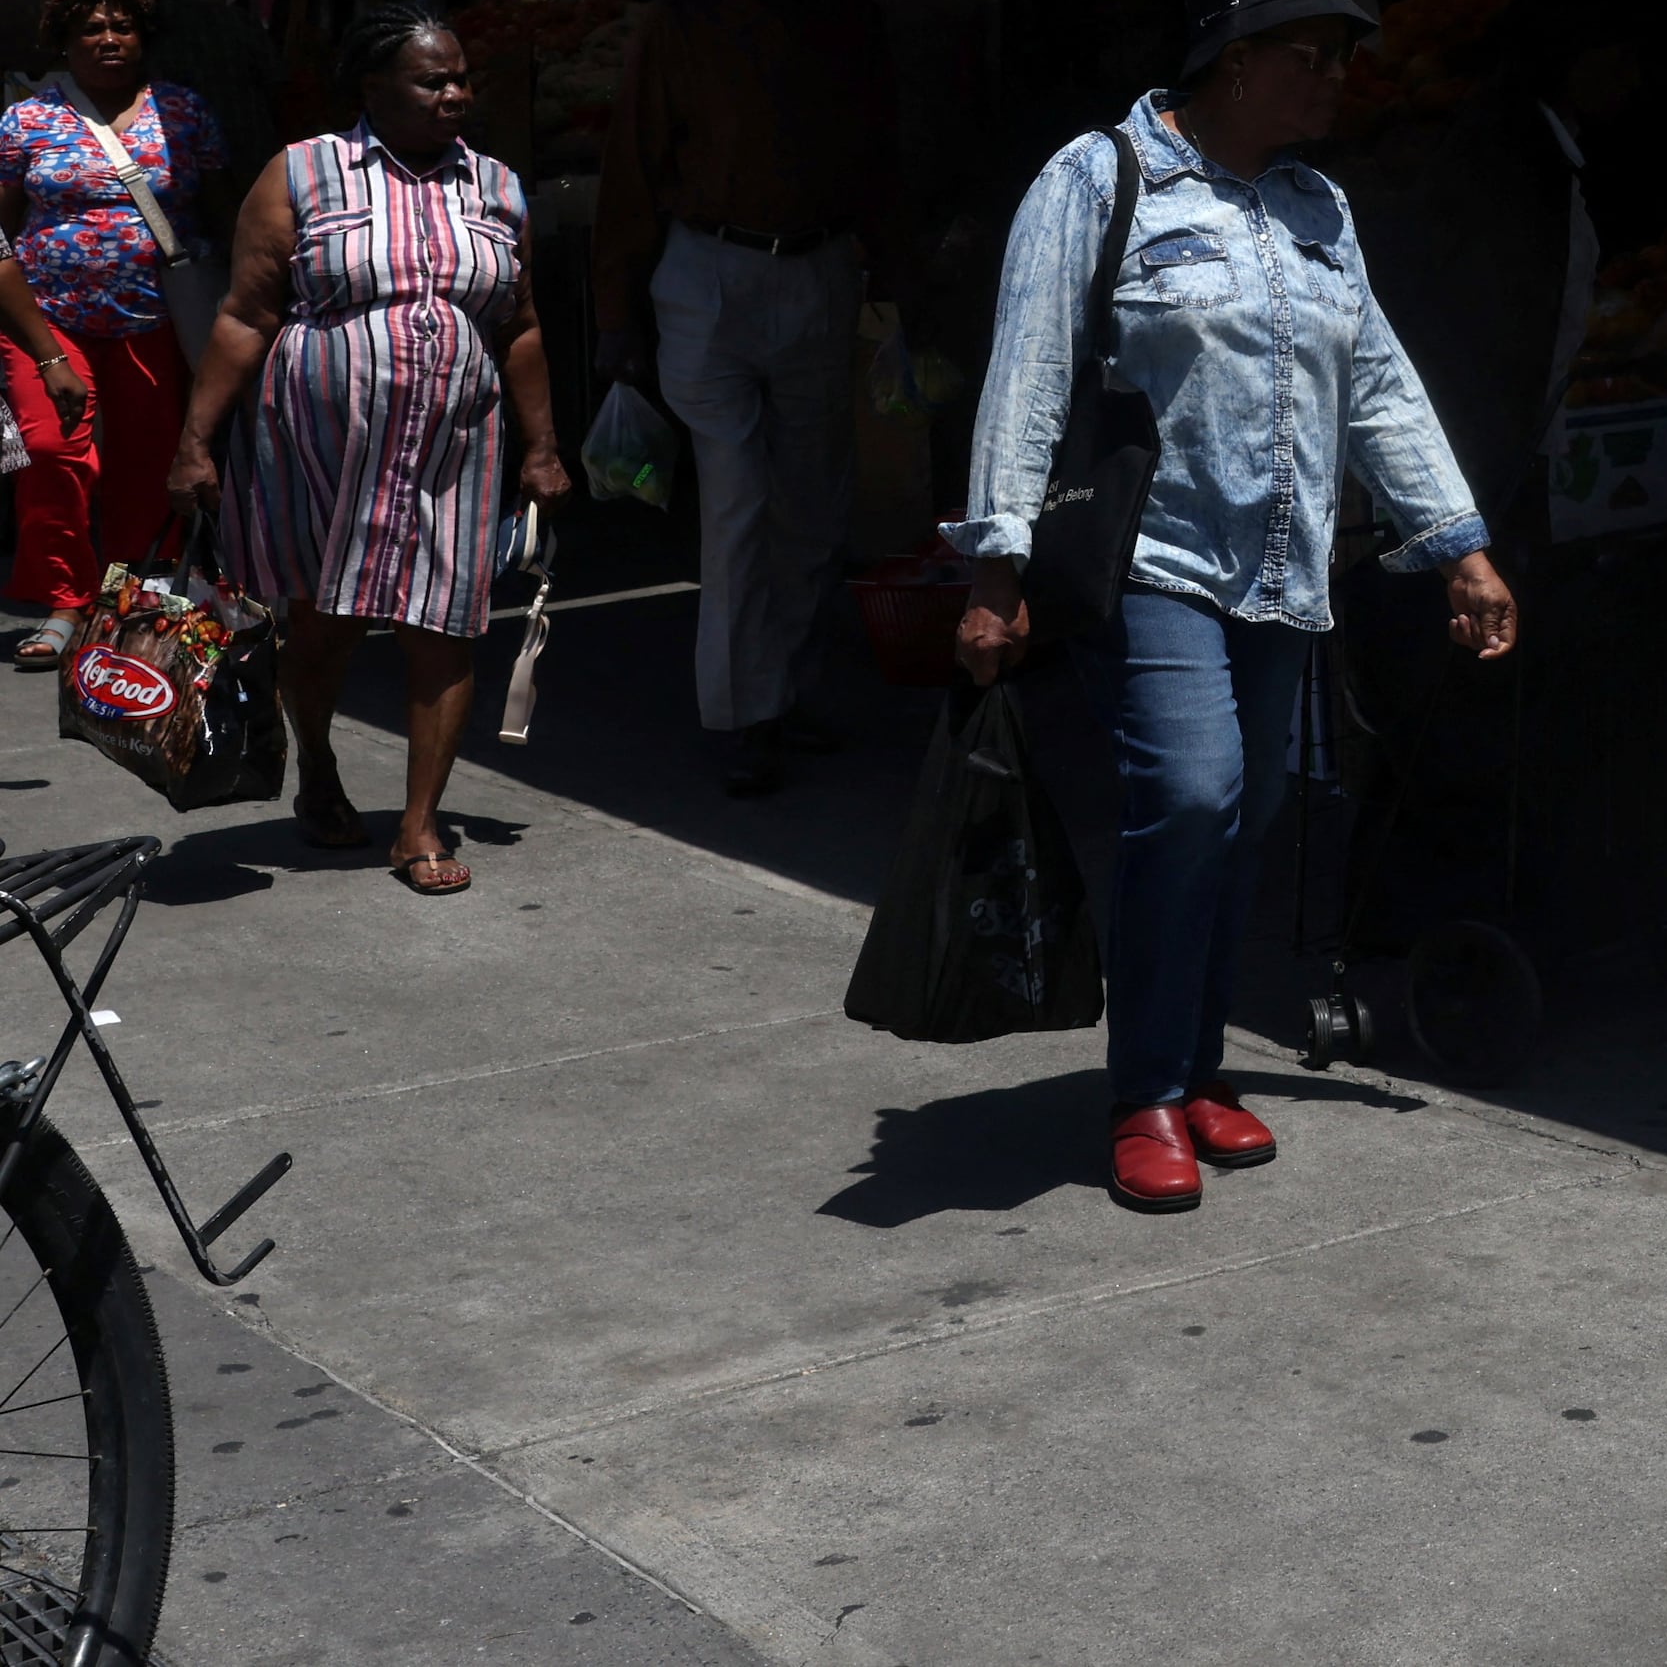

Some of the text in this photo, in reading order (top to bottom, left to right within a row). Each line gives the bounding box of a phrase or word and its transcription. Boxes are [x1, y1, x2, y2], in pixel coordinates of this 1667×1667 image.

[78, 649, 165, 706] Key Food
[129, 737, 154, 756] Key
